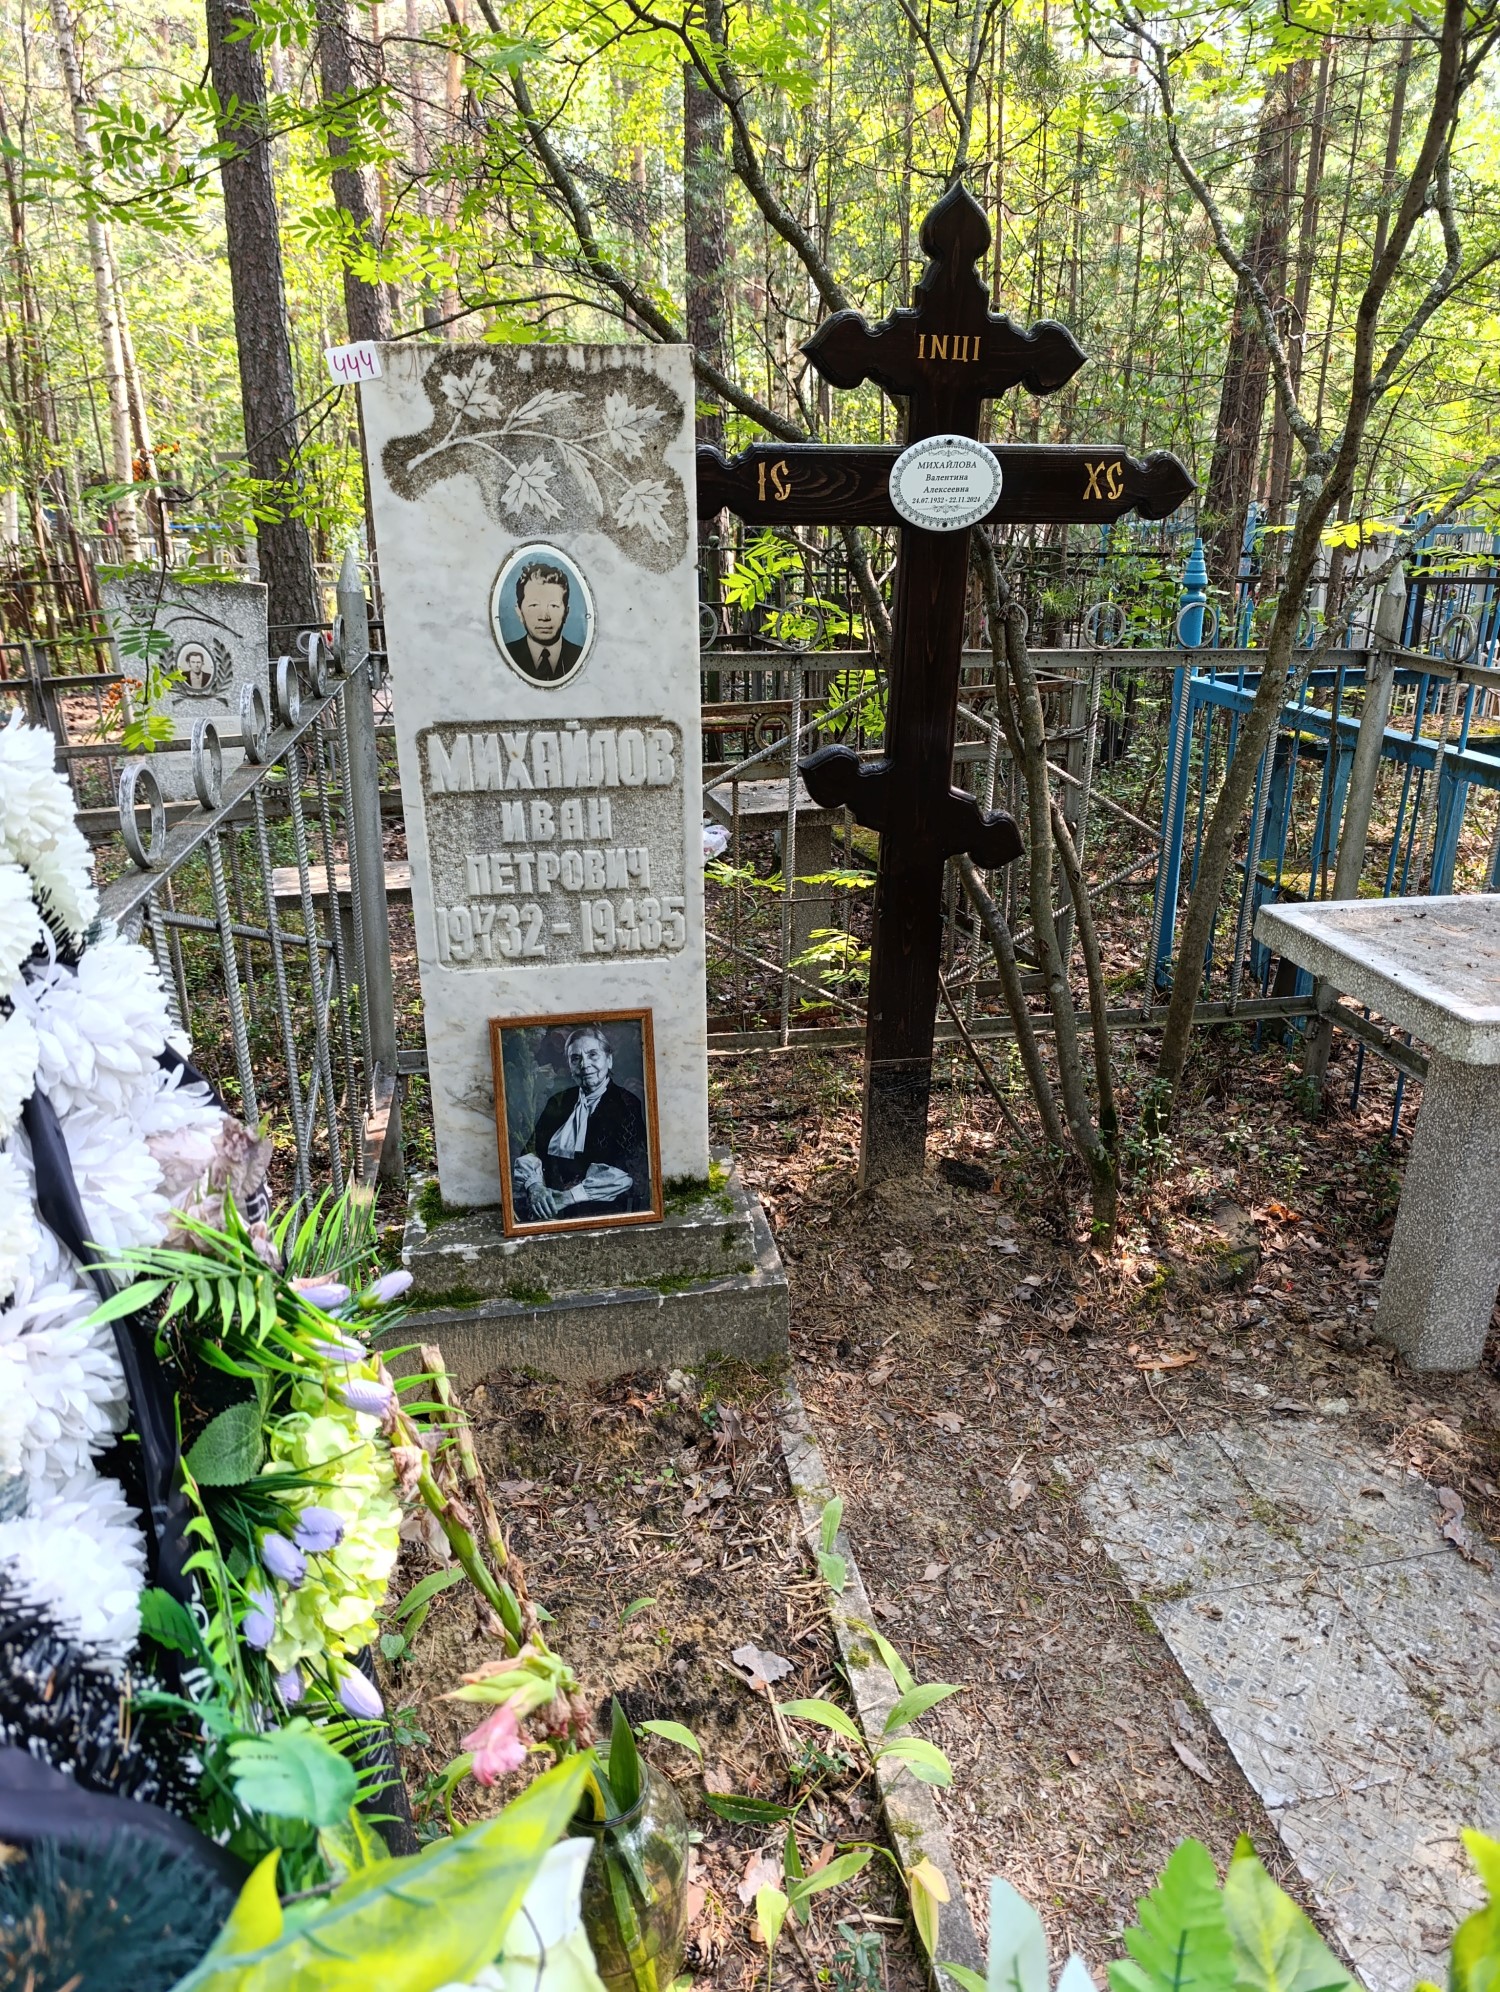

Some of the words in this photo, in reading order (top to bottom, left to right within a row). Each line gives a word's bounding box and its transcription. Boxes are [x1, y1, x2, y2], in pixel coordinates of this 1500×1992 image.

[917, 460, 977, 469] МИХАЙЛОВА
[925, 473, 969, 481] Валентина
[427, 720, 676, 792] МИХАЙЛОВ
[501, 797, 612, 842] ИВАН
[465, 847, 650, 895] ПЕТРОВИЧ
